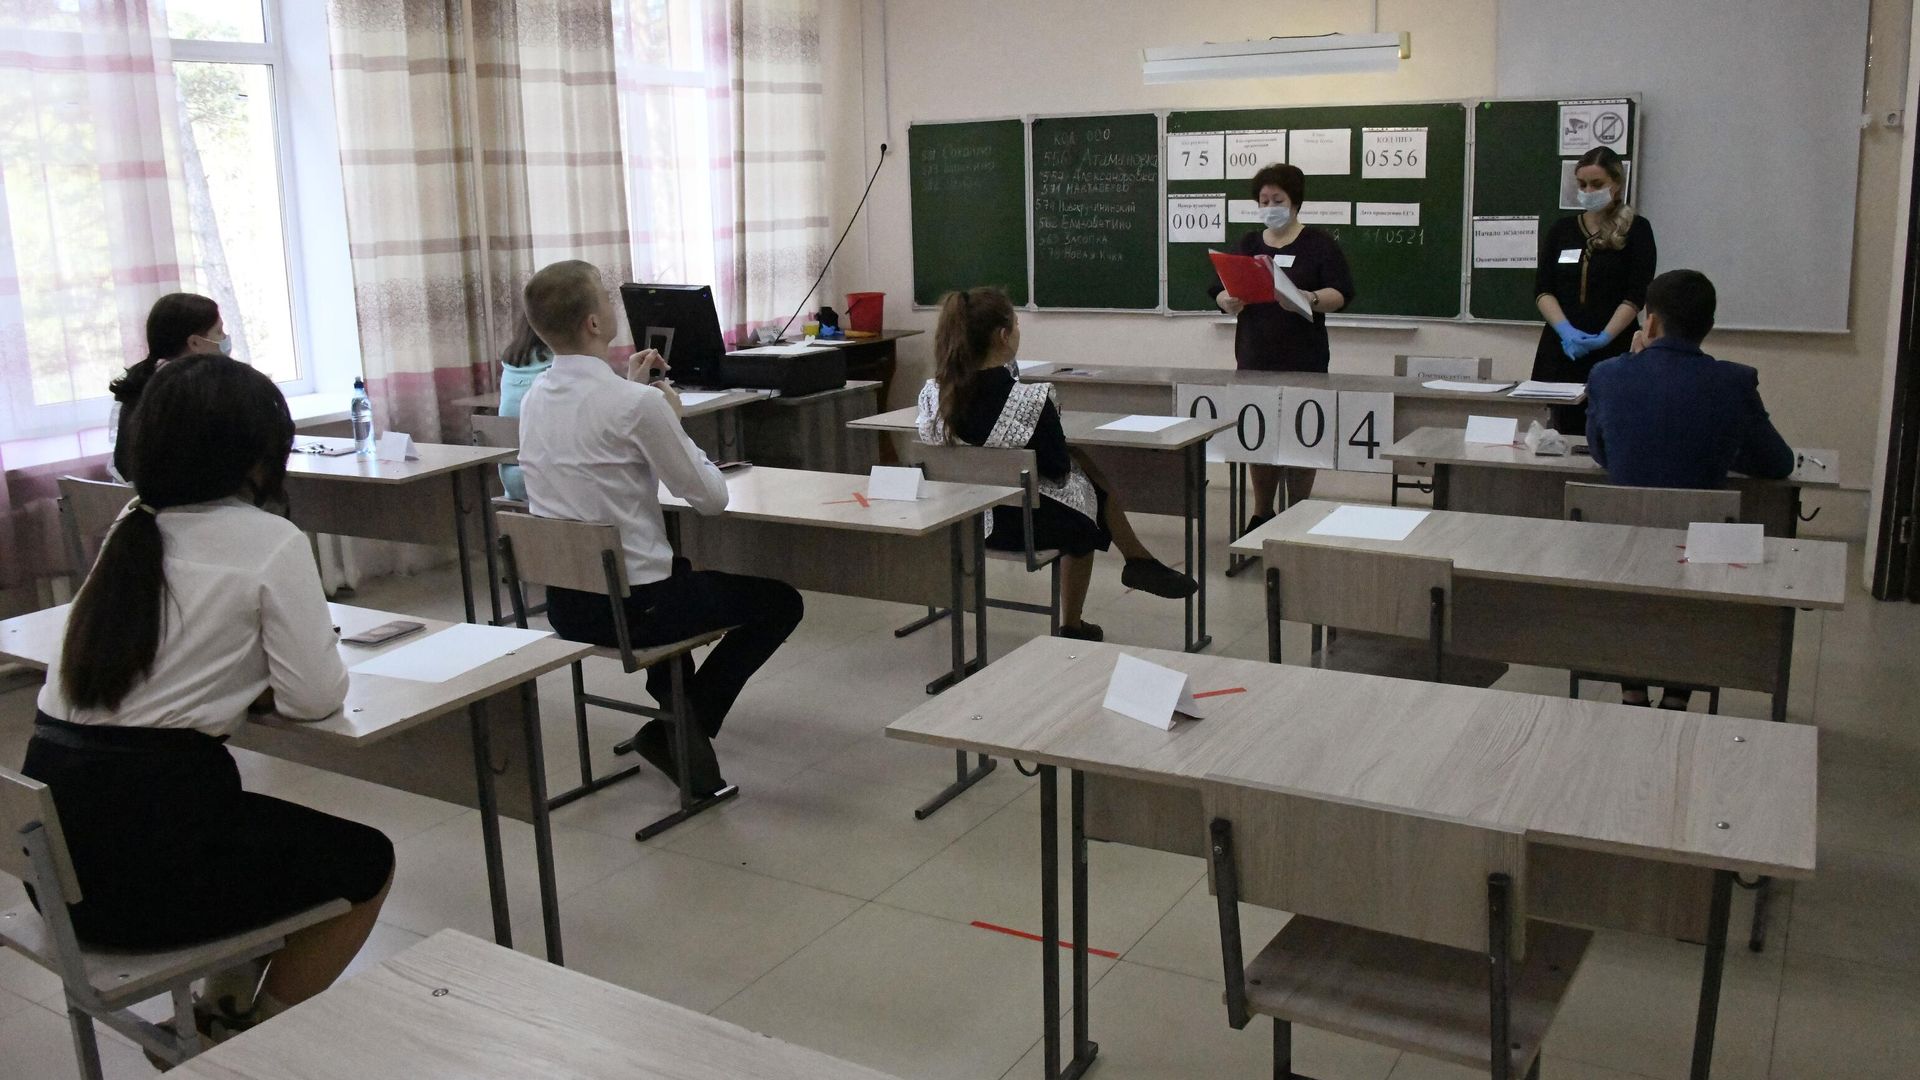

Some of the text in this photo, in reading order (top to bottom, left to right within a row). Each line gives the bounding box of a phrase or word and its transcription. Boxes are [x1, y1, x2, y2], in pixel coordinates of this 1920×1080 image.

[1230, 152, 1257, 167] 000
[1365, 150, 1418, 167] 0556
[1173, 213, 1221, 229] 0004
